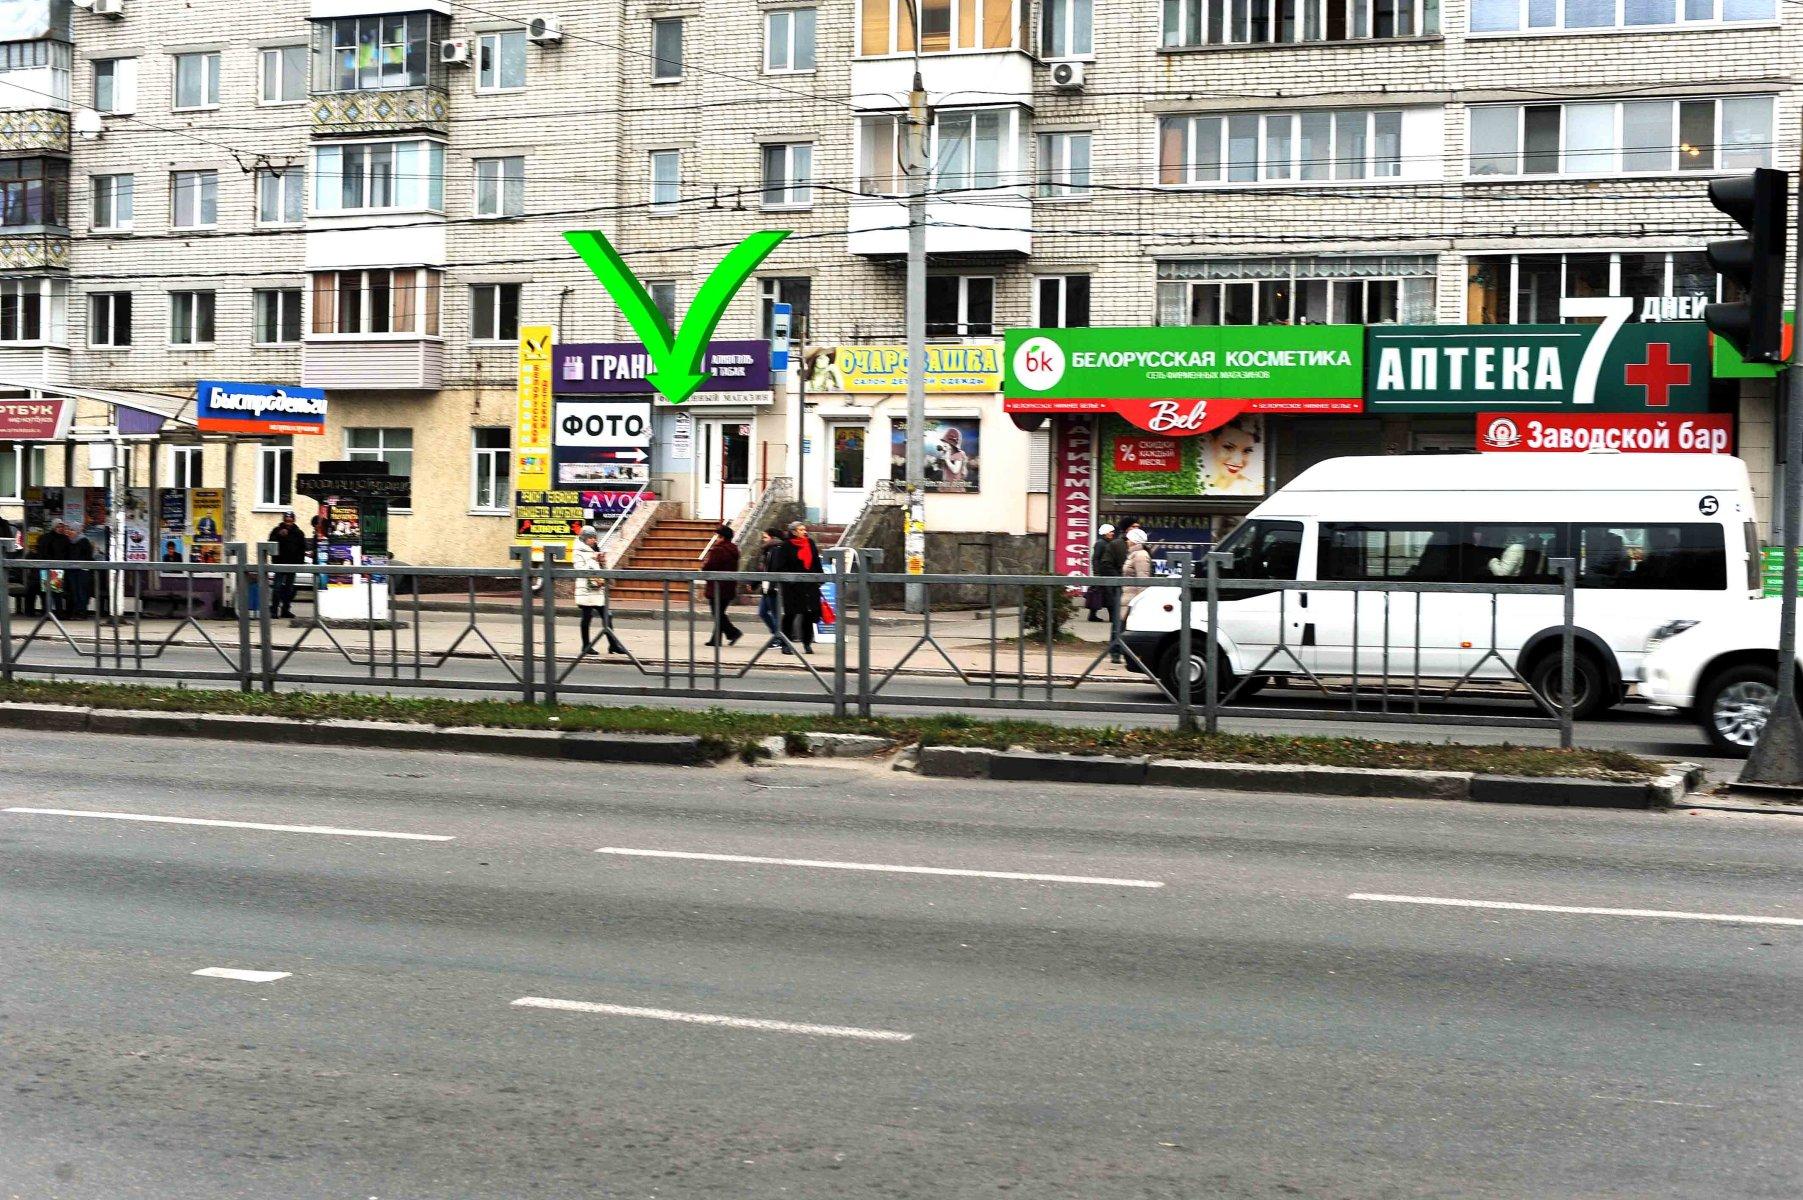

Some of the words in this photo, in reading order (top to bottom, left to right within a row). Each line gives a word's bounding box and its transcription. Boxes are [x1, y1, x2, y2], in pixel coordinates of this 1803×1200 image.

[1375, 346, 1563, 390] АПТЕКА
[1559, 297, 1633, 404] 7
[1640, 291, 1709, 323] ДНЕЙ
[841, 349, 999, 374] ОЧАРОАШКА
[1072, 351, 1215, 368] БЕЛОРУССКАЯ
[1226, 350, 1352, 367] КОСМЕТИКА
[1219, 371, 1270, 379] МАГАЗИНОВ
[723, 393, 769, 402] МАГАЗИН
[562, 415, 644, 437] ФОТО
[1527, 421, 1670, 450] Заводской
[1678, 421, 1728, 454] бар
[1138, 449, 1175, 457] КАЖДЫЙ
[1700, 497, 1718, 515] 5
